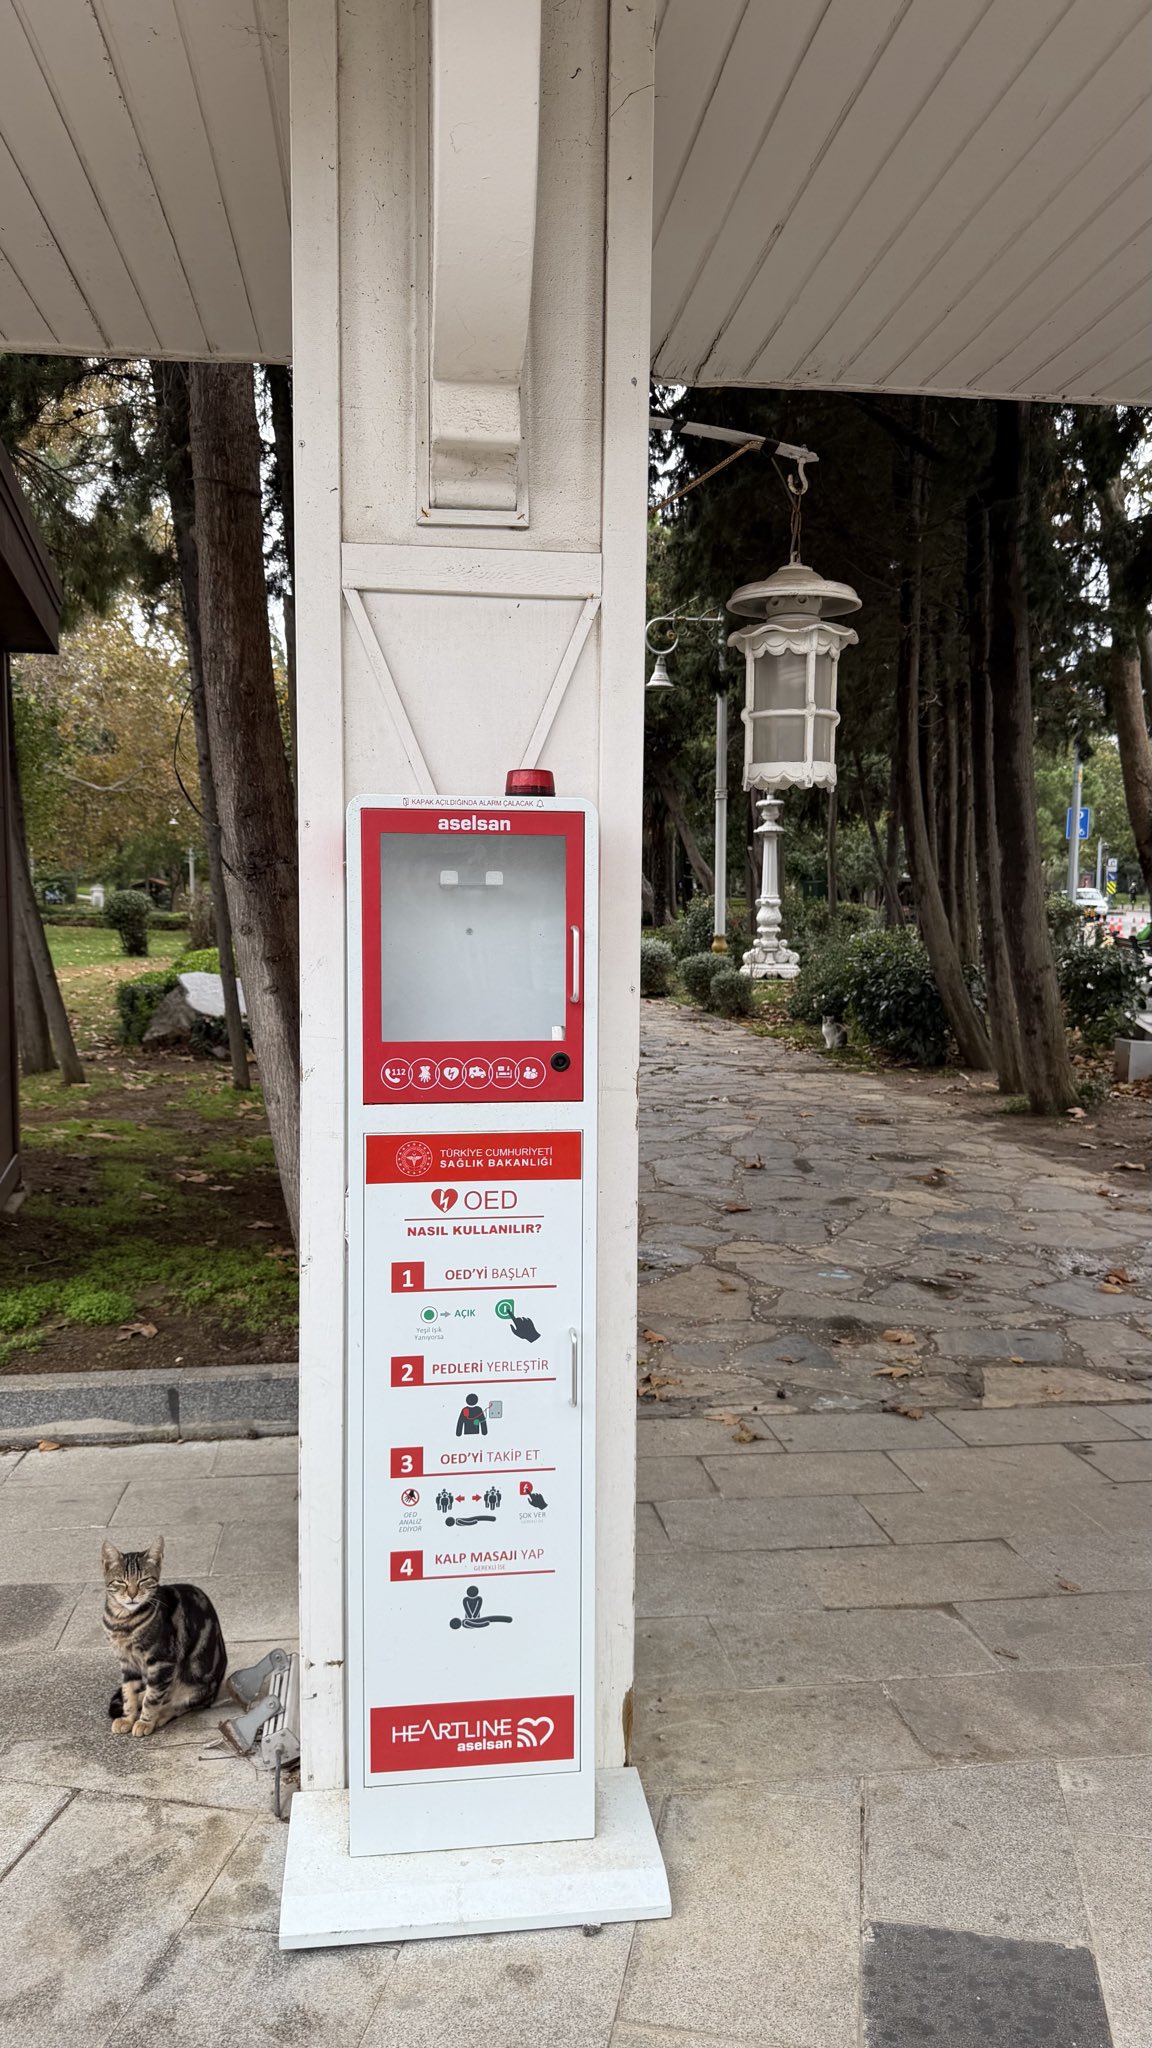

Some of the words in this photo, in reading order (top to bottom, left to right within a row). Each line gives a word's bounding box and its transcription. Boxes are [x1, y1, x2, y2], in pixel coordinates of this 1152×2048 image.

[438, 815, 511, 831] aselsan
[440, 1148, 482, 1157] TÜRKİYE
[485, 1146, 552, 1156] CUMHURİYETİ
[440, 1158, 484, 1168] SAĞLIK
[488, 1157, 552, 1167] BAKANLIĞI
[464, 1190, 518, 1210] OED
[407, 1226, 448, 1237] NASIL
[453, 1224, 542, 1235] KULLANILIR?
[402, 1270, 414, 1287] 1
[492, 1267, 537, 1281] BAŞLAT
[454, 1309, 476, 1319] AÇIK
[401, 1364, 413, 1382] 2
[432, 1360, 483, 1374] PEDLERİ
[487, 1358, 548, 1374] YERLEŞTİR
[400, 1455, 413, 1472] 3
[487, 1449, 522, 1462] TAKİP
[526, 1450, 540, 1460] ET
[519, 1512, 532, 1520] ŞOK
[400, 1558, 413, 1576] 4
[435, 1553, 466, 1564] KALP
[470, 1550, 517, 1562] MASAJI
[521, 1549, 544, 1560] YAP
[392, 1718, 512, 1743] HEARTLINE
[457, 1739, 512, 1752] aselsan
